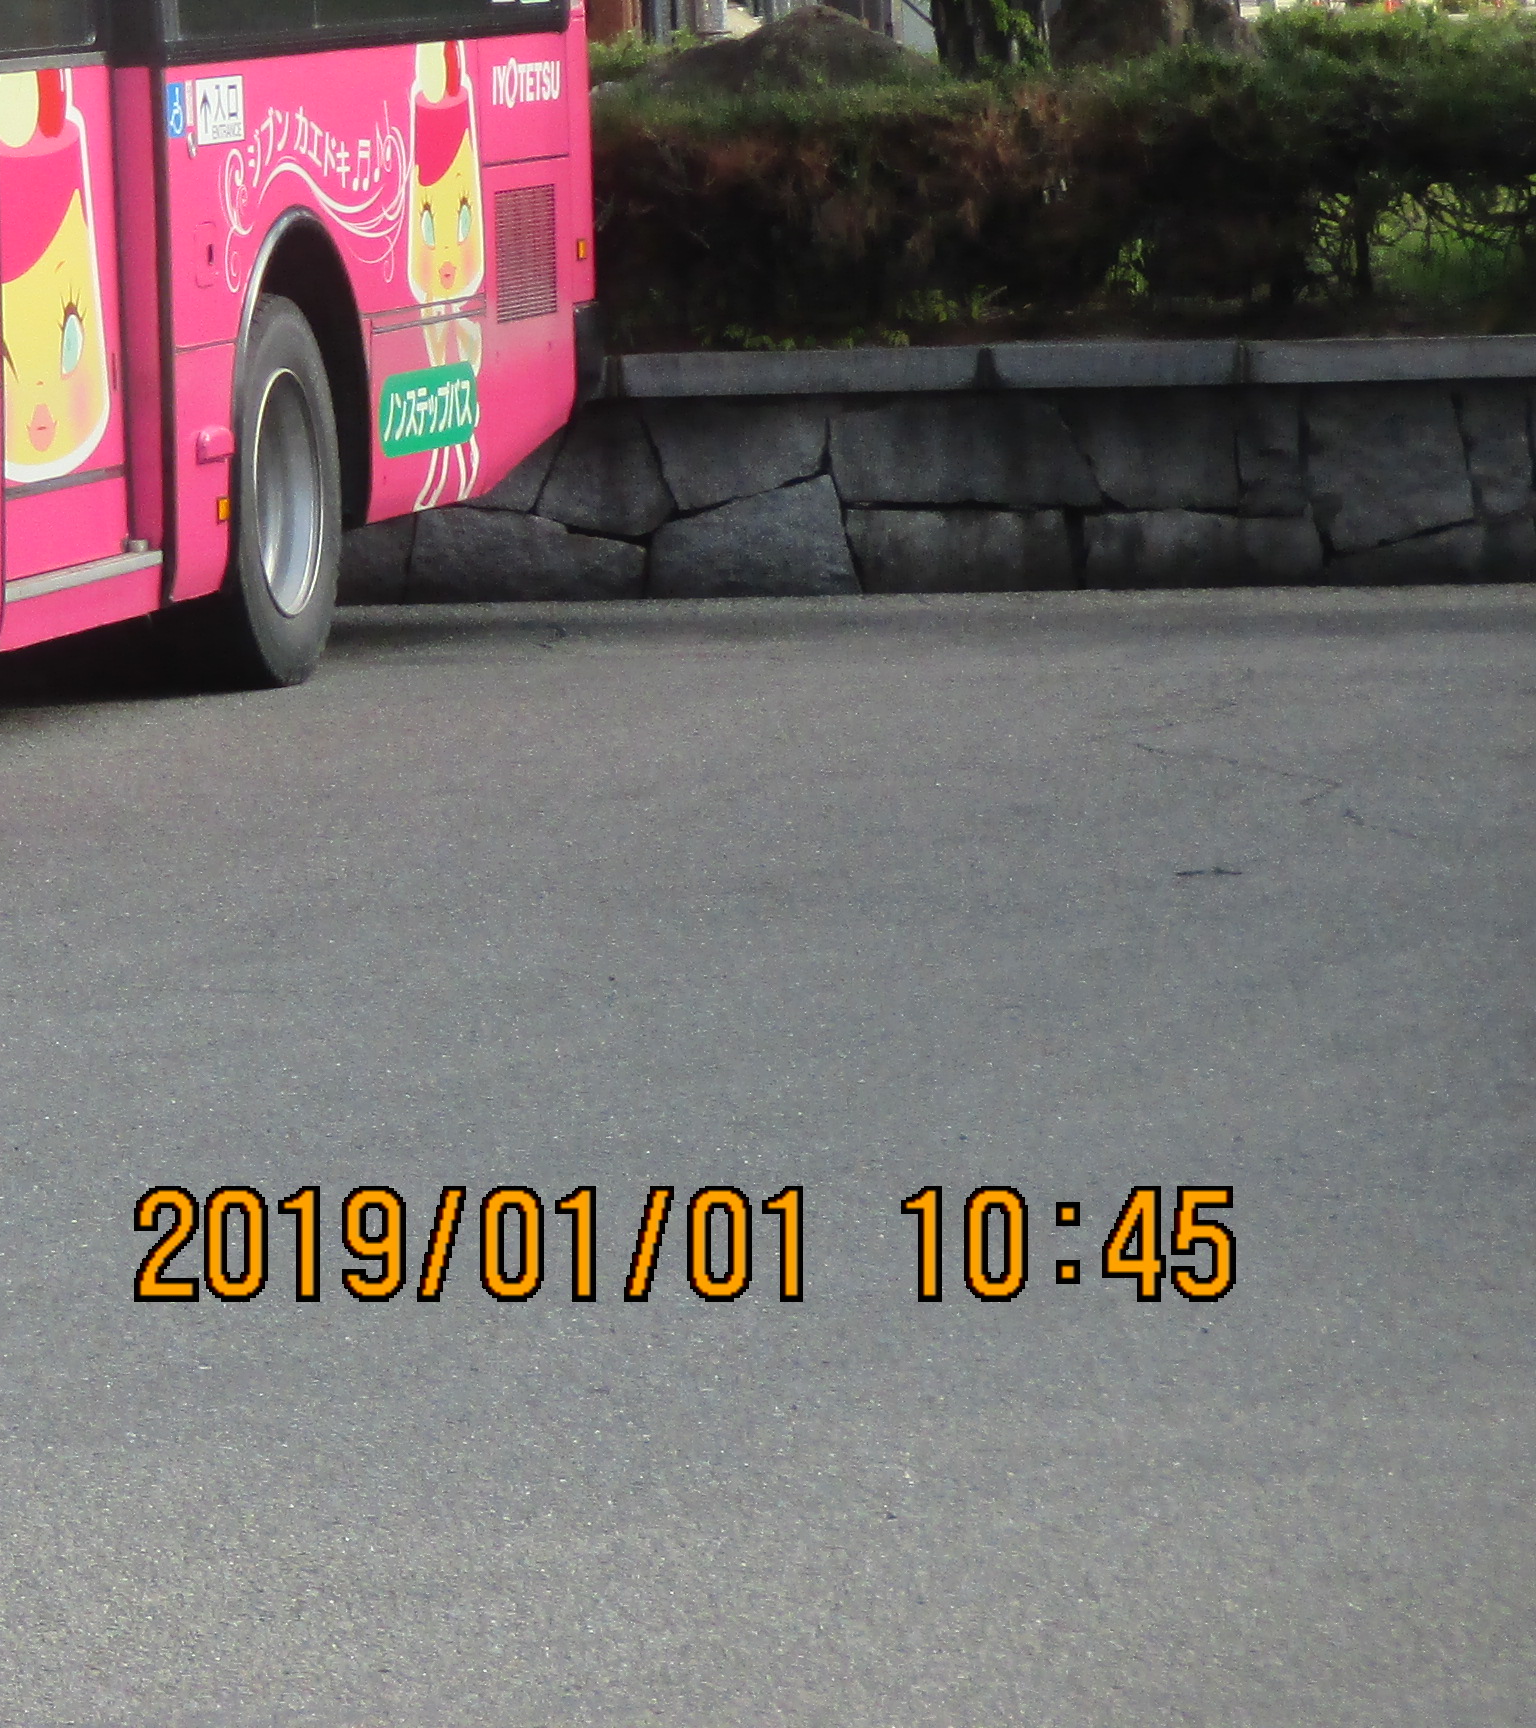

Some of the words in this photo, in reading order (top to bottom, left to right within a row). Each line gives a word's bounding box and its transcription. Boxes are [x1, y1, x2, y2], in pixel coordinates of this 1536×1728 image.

[213, 84, 239, 122] 入口
[491, 57, 562, 109] IYOTETSU
[383, 378, 473, 442] ノンステップバス
